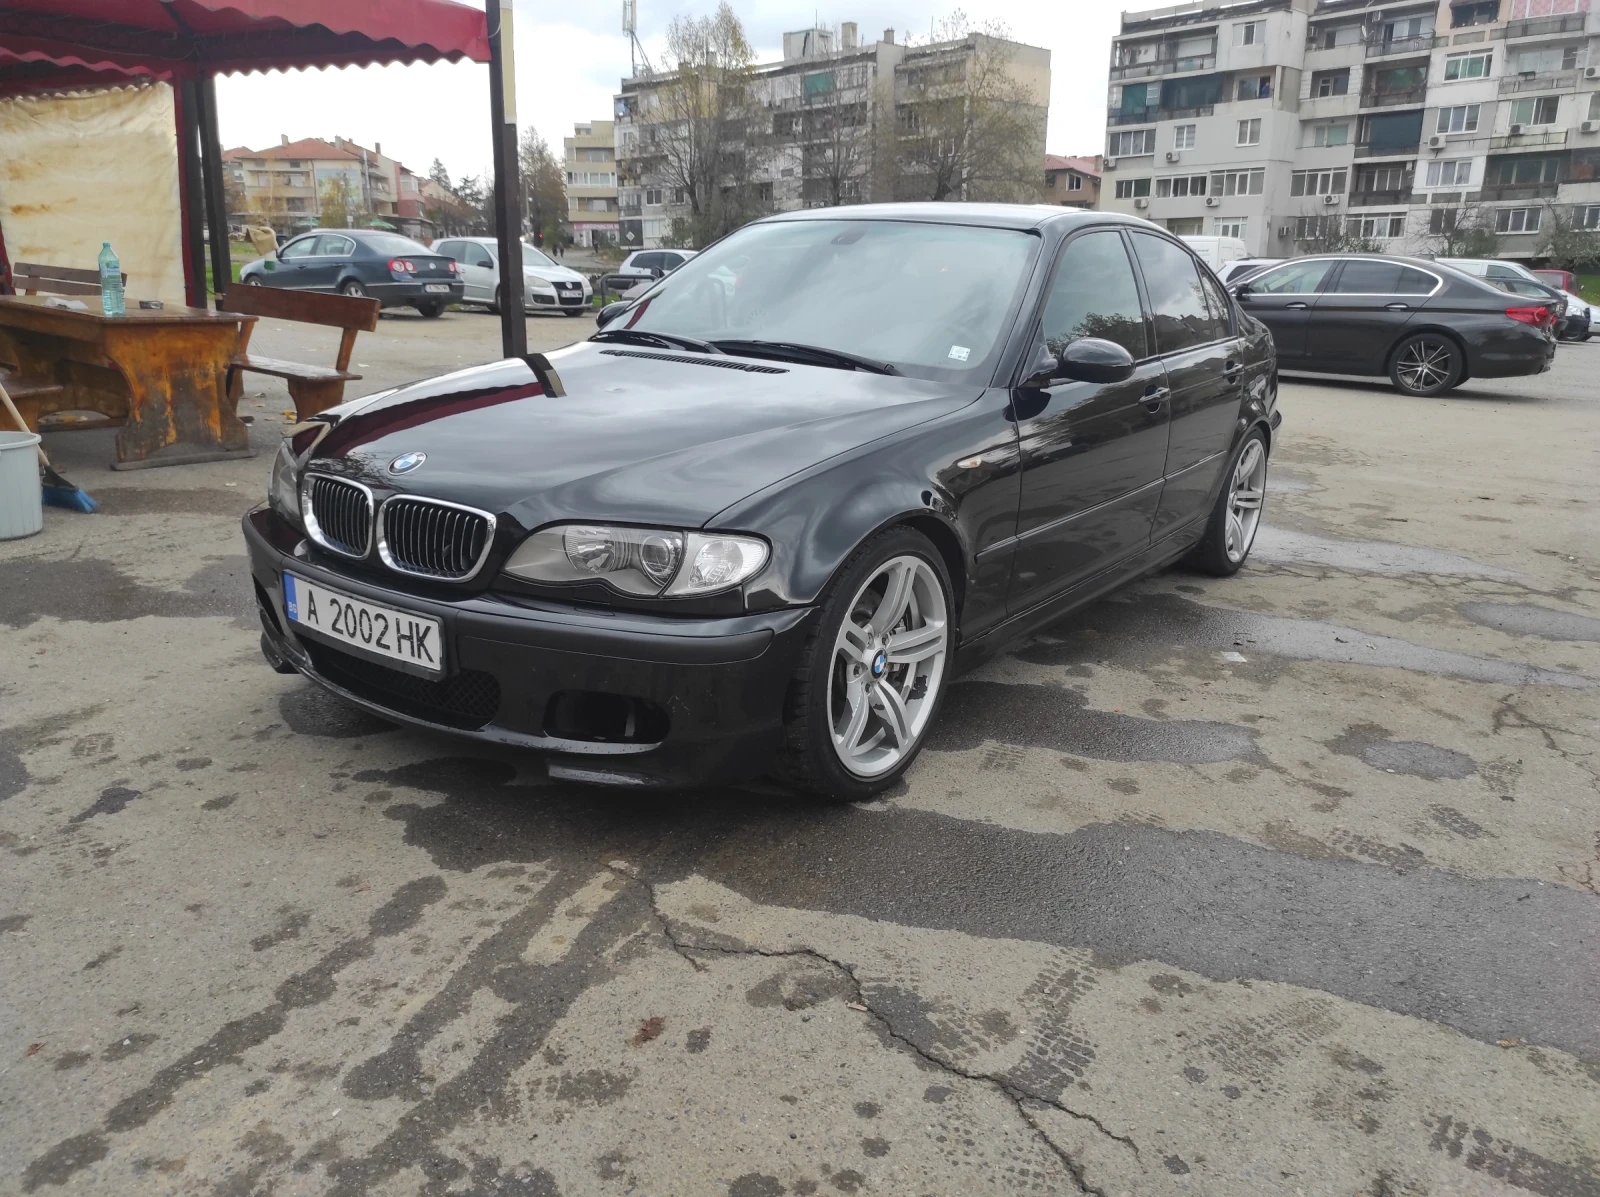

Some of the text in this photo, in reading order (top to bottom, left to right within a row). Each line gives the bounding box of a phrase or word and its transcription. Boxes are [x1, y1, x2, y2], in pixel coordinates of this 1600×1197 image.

[288, 601, 298, 614] BG
[308, 589, 434, 663] A 2002 HK
